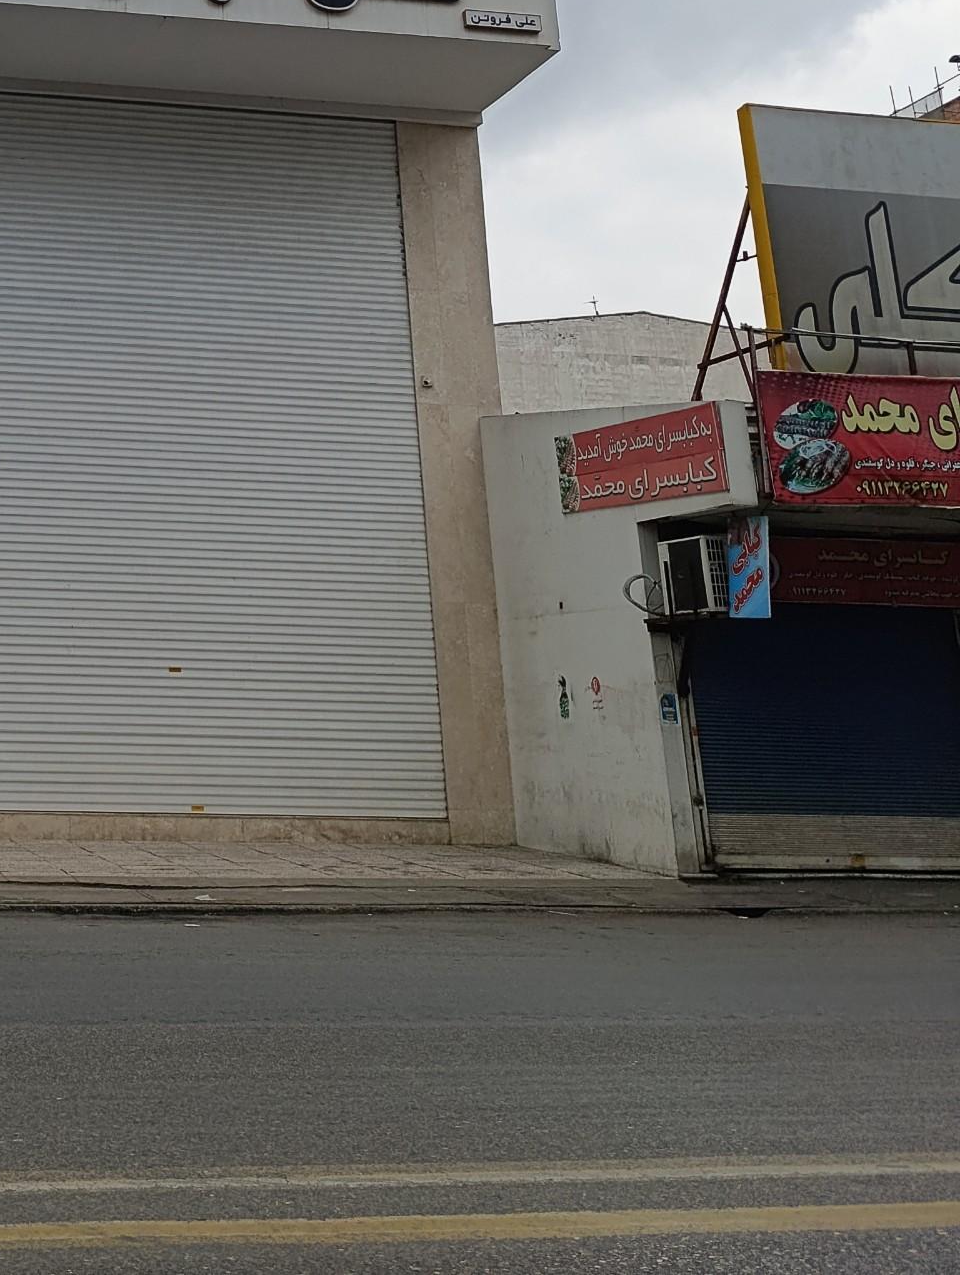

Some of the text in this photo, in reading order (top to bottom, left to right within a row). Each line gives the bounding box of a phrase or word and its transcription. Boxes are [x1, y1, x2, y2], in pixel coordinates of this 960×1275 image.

[470, 14, 537, 28] علی فروتن
[841, 393, 921, 434] محمد
[603, 433, 628, 462] خوش
[655, 415, 700, 453] کبابسرای
[700, 421, 713, 443] به
[577, 433, 602, 466] آمدید
[855, 458, 884, 470] گوسفندی
[628, 456, 717, 499] کبابسرای
[733, 567, 764, 614] محمد
